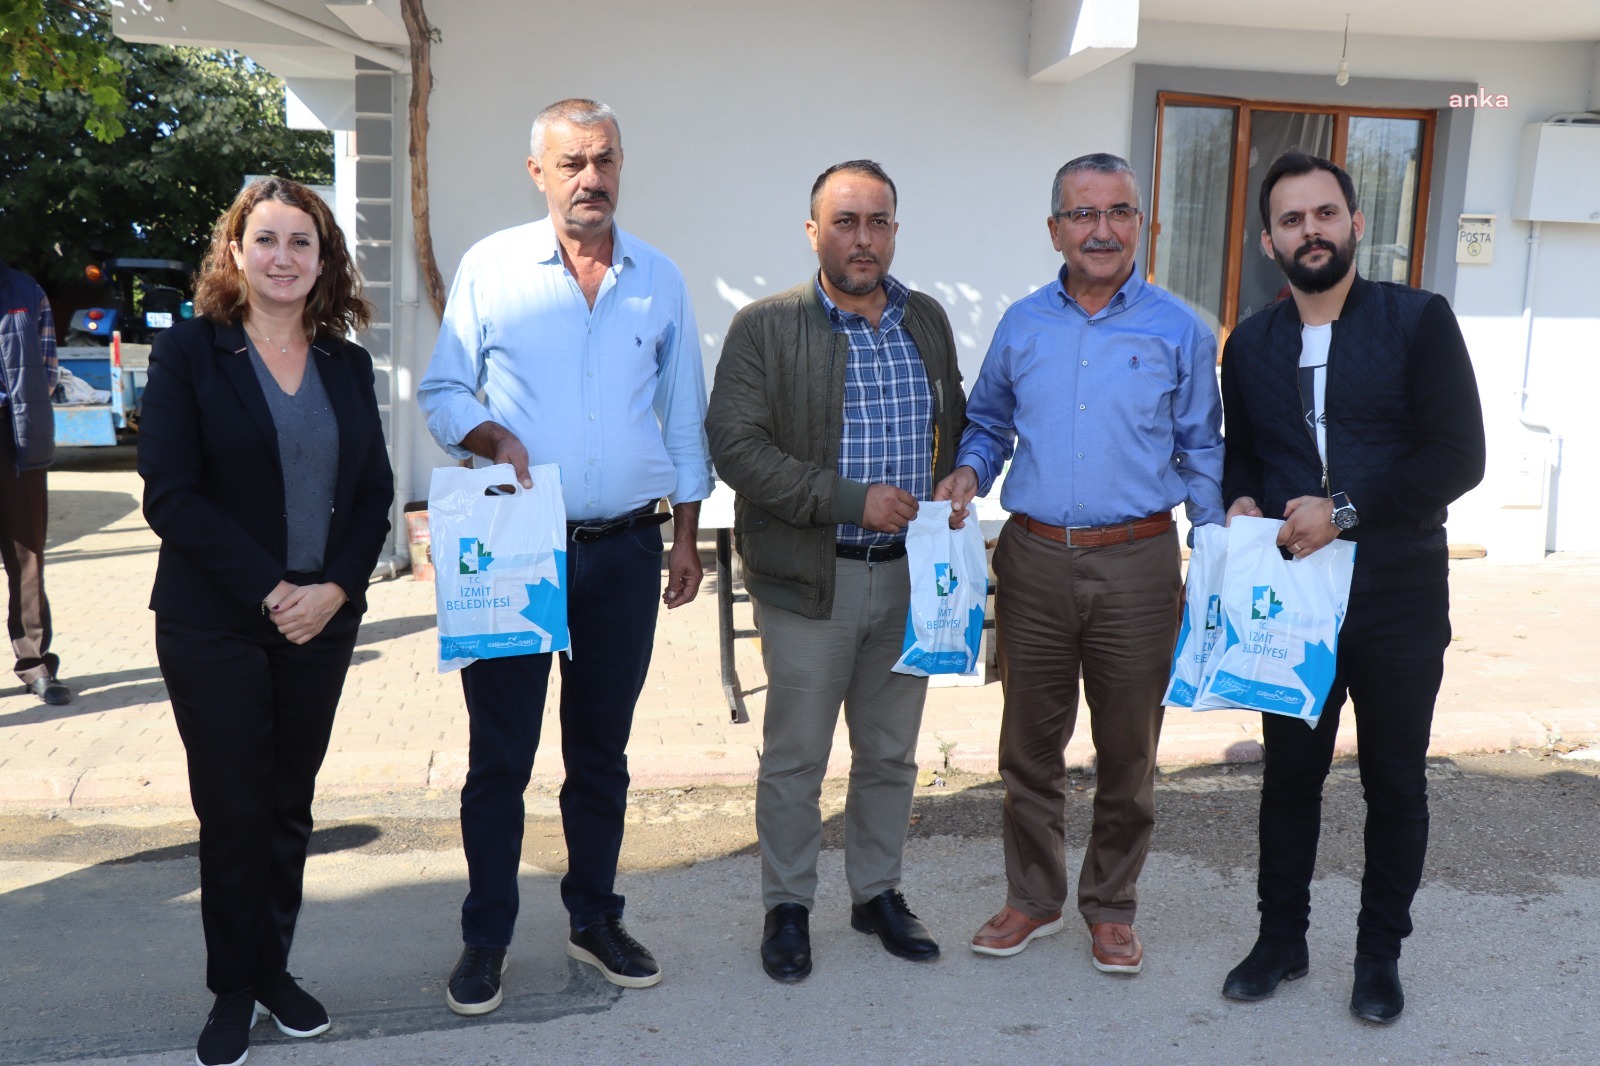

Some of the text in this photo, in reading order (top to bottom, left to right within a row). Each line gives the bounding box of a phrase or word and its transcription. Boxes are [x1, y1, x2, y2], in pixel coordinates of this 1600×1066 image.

[1460, 230, 1491, 243] POSTA
[460, 585, 491, 597] İZMİT
[446, 595, 510, 611] BELEDİYESİ
